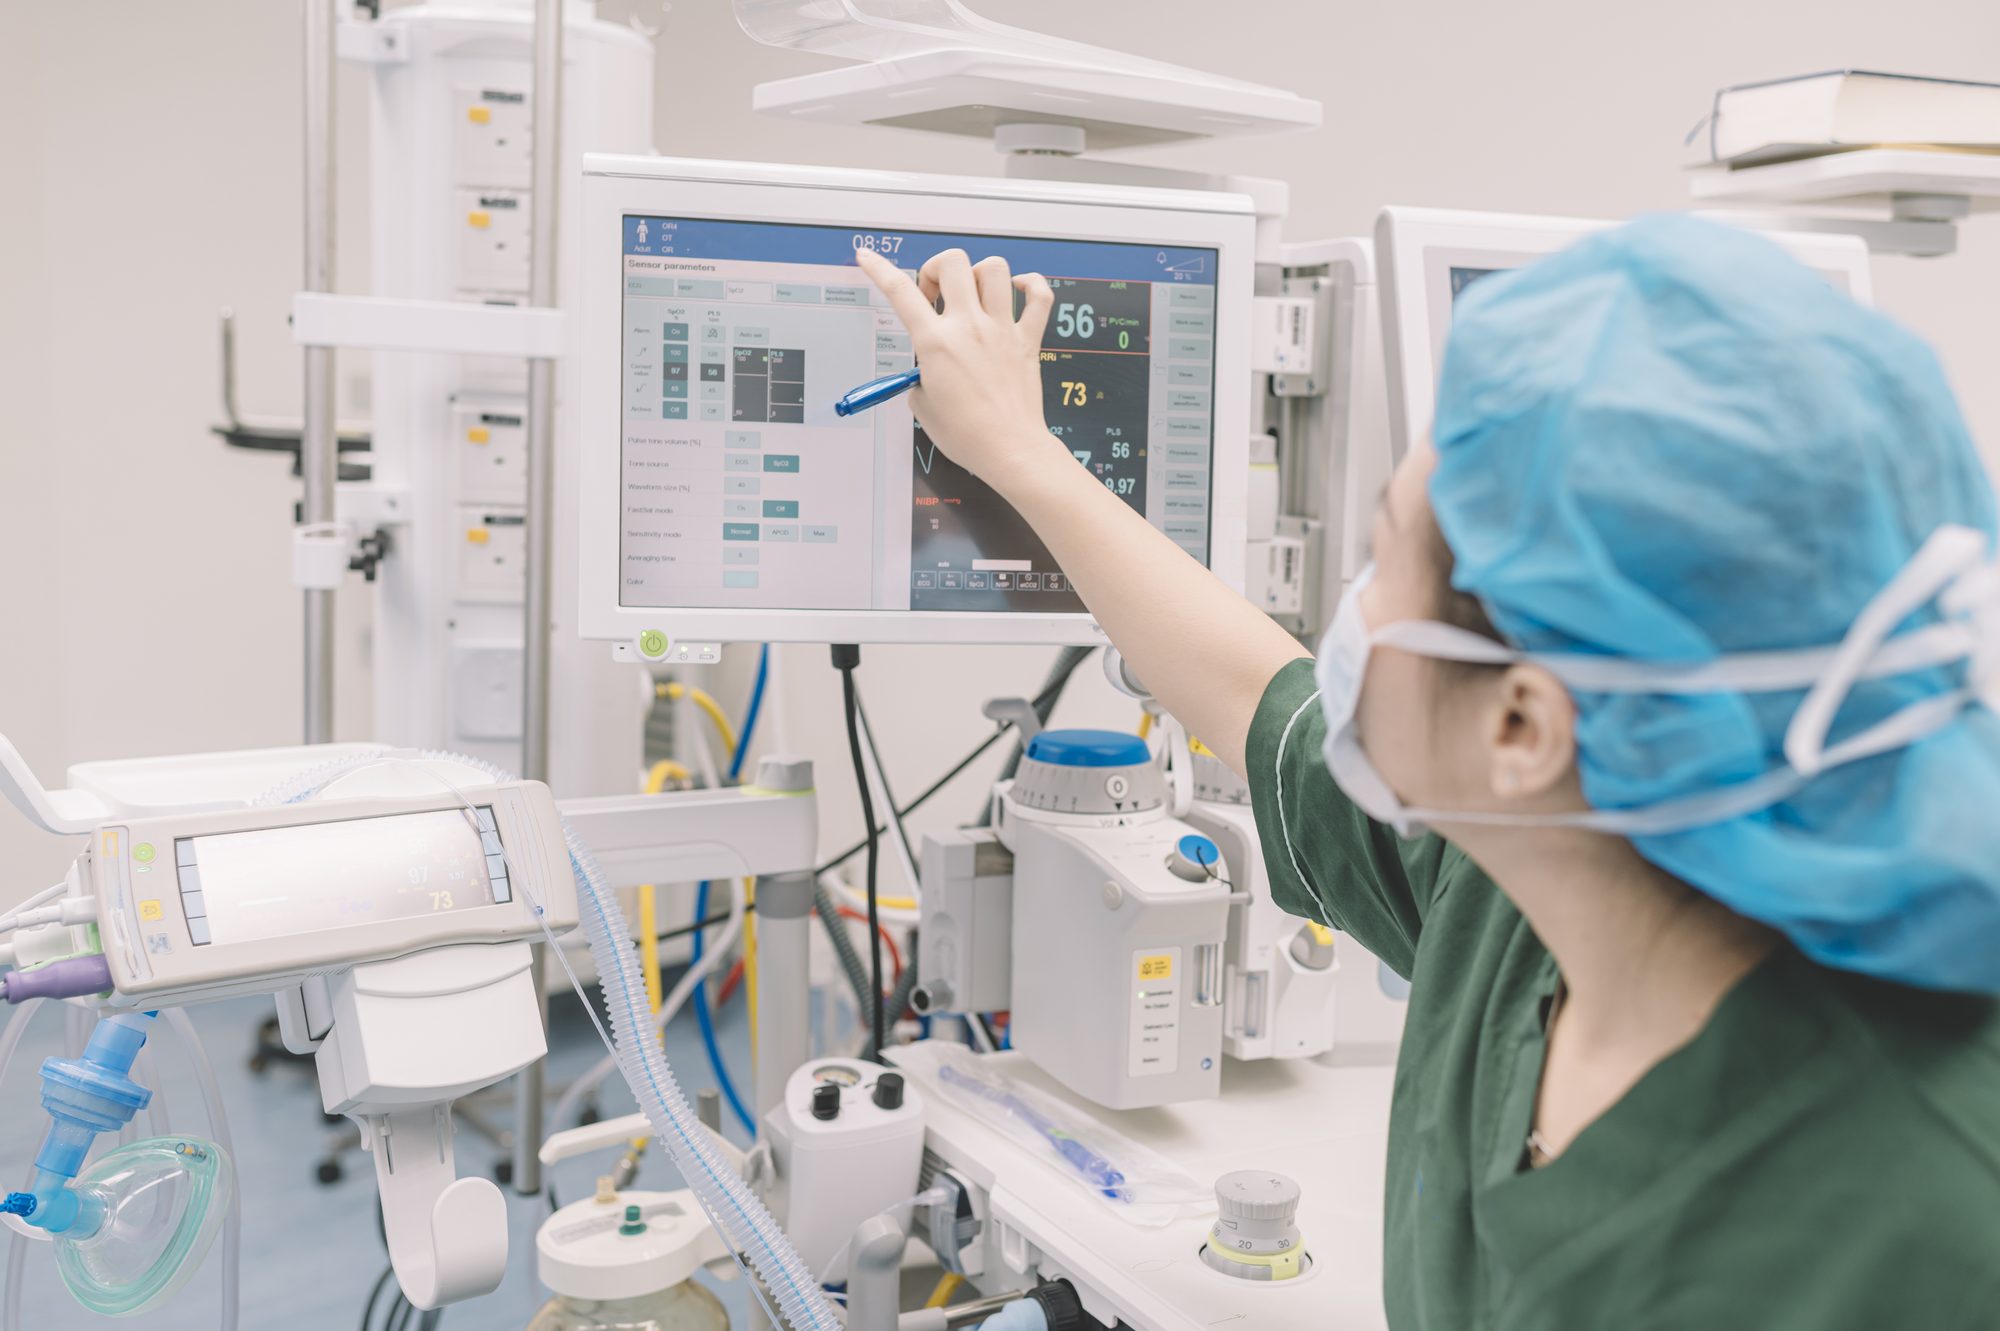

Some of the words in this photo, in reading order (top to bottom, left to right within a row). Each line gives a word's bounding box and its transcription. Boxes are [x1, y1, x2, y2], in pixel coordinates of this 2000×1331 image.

[853, 234, 903, 253] 08:57
[628, 259, 661, 268] Sensor
[664, 262, 716, 272] parameters
[1056, 303, 1095, 339] 56
[1118, 330, 1130, 350] 0
[1061, 381, 1087, 407] 73
[1112, 442, 1130, 458] 56
[1105, 477, 1136, 495] 9.97
[916, 497, 939, 506] NIBP
[408, 865, 429, 885] 97
[428, 890, 454, 911] 73
[1238, 1240, 1253, 1250] 20
[1278, 1239, 1290, 1249] 30
